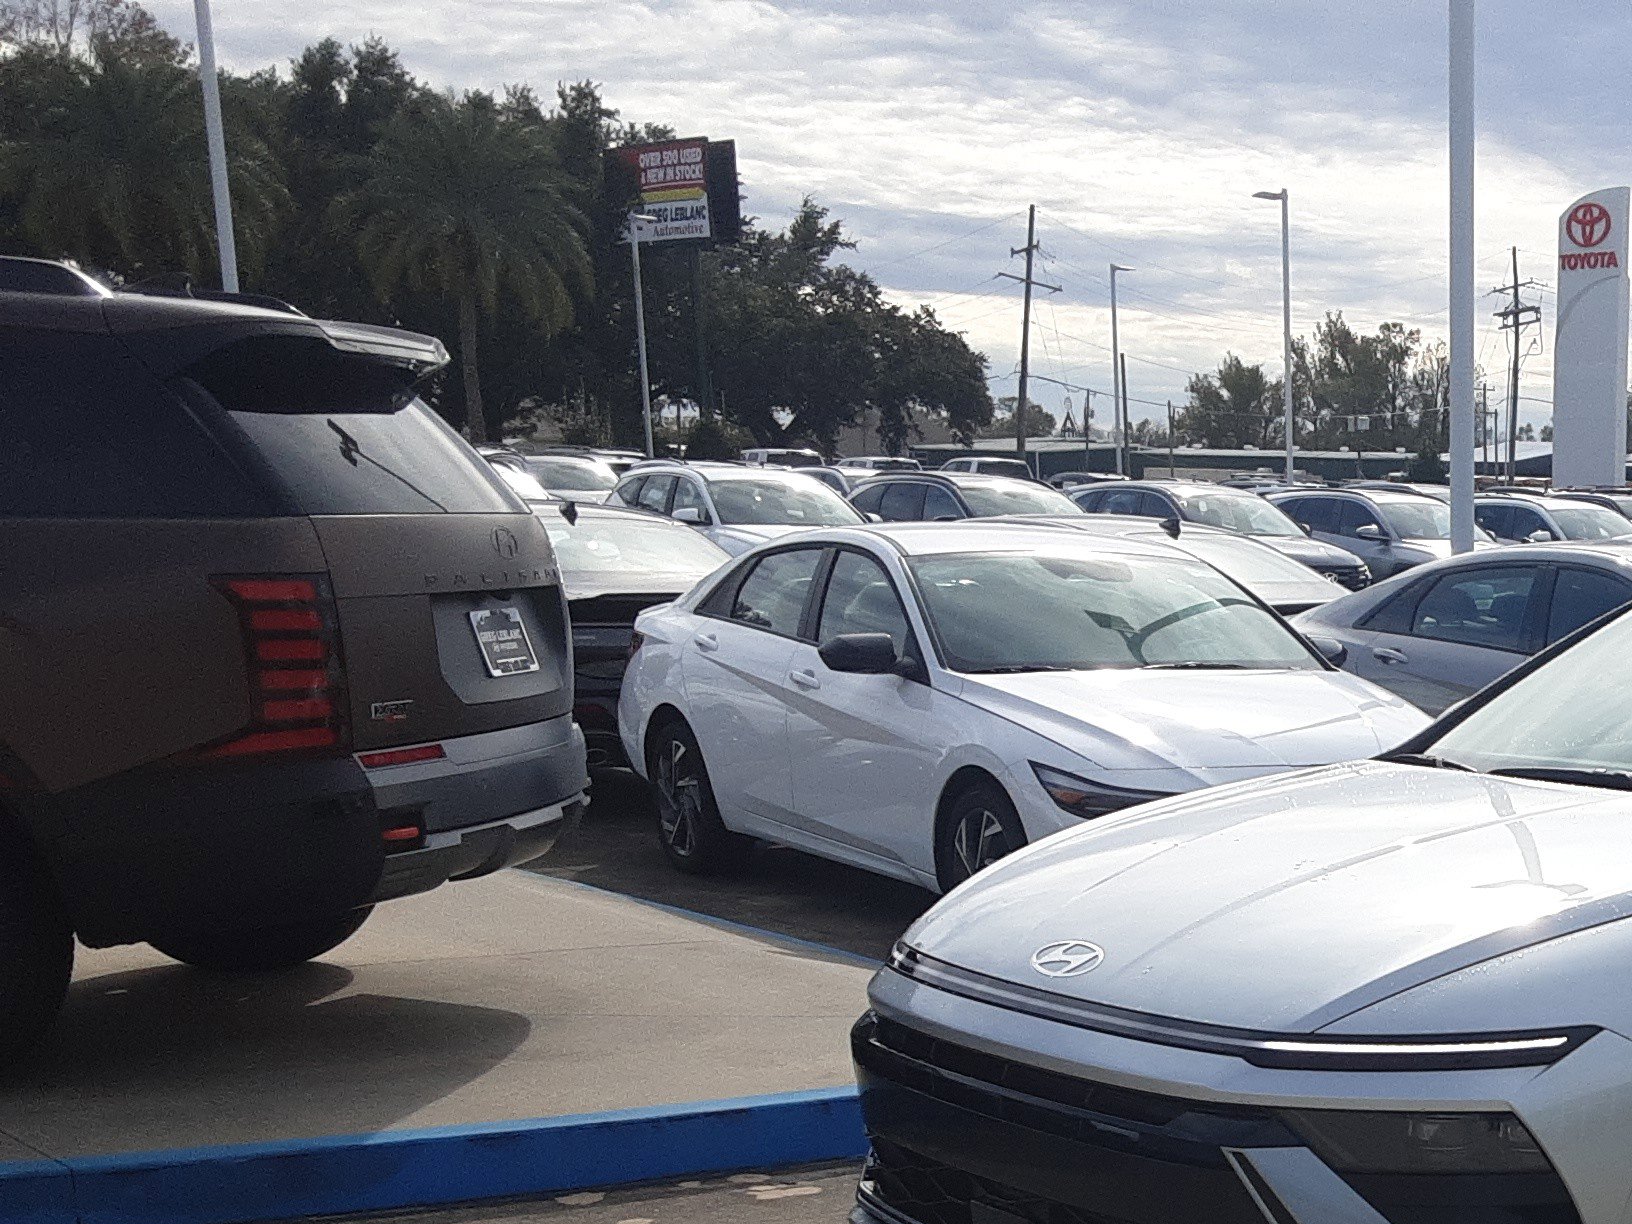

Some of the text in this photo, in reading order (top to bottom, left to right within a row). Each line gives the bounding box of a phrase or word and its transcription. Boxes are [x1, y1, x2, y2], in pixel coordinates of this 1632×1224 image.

[639, 152, 661, 168] OVER
[680, 147, 702, 164] USED
[647, 167, 665, 183] NEW
[670, 205, 707, 222] LEBLANC
[653, 222, 704, 237] Automotive
[1559, 251, 1619, 271] TOYOTA
